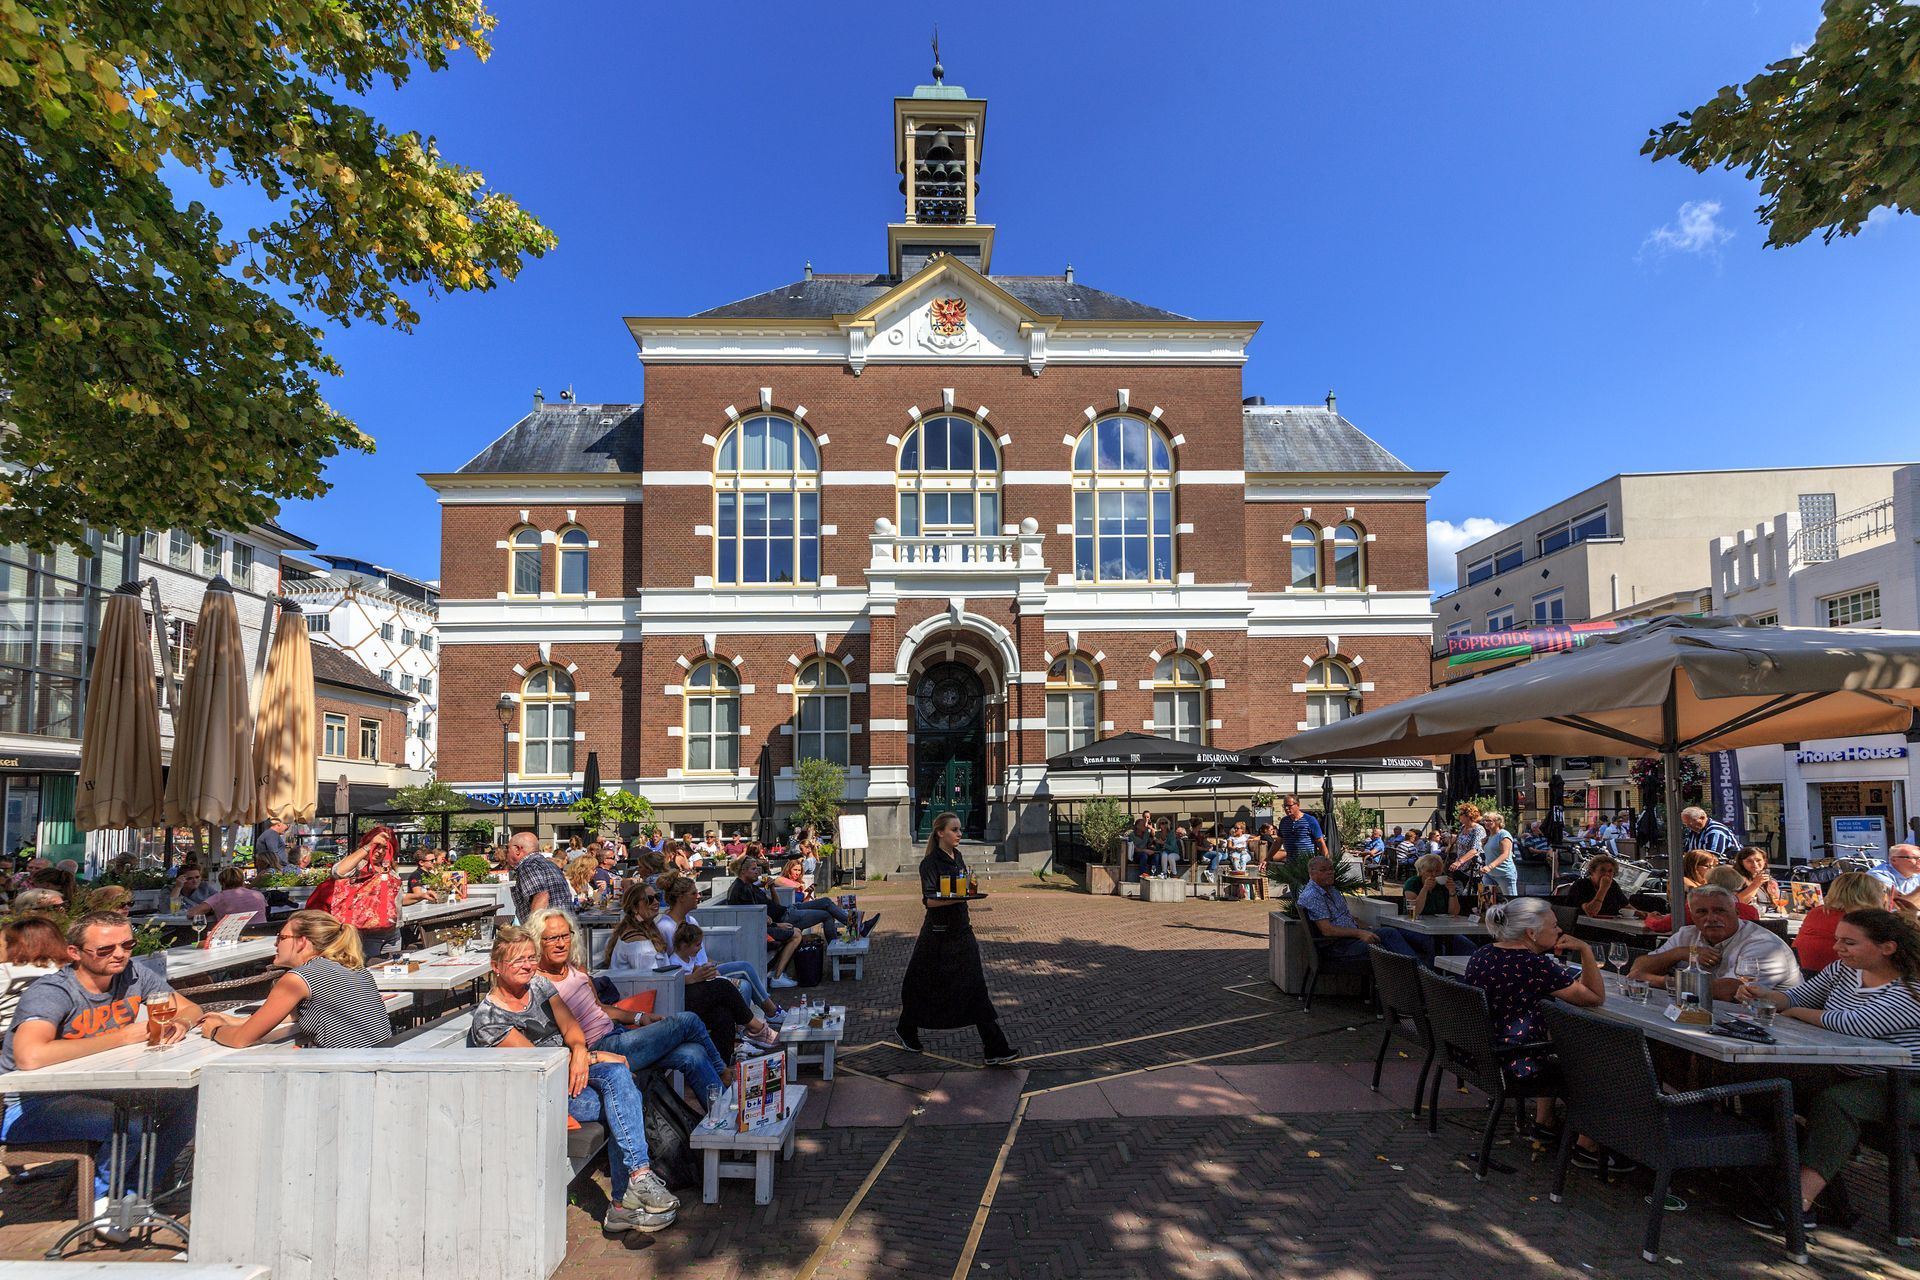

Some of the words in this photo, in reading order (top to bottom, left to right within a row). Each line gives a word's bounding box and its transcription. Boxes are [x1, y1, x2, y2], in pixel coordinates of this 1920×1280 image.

[1448, 630, 1534, 654] POPRONDE
[1083, 756, 1104, 765] Brand
[1202, 753, 1239, 763] DISARONNO
[1387, 758, 1423, 767] DISARONNO
[1794, 749, 1843, 763] Phone
[1844, 747, 1902, 761] House
[467, 791, 584, 807] ESTAURAN
[1722, 788, 1735, 823] hone
